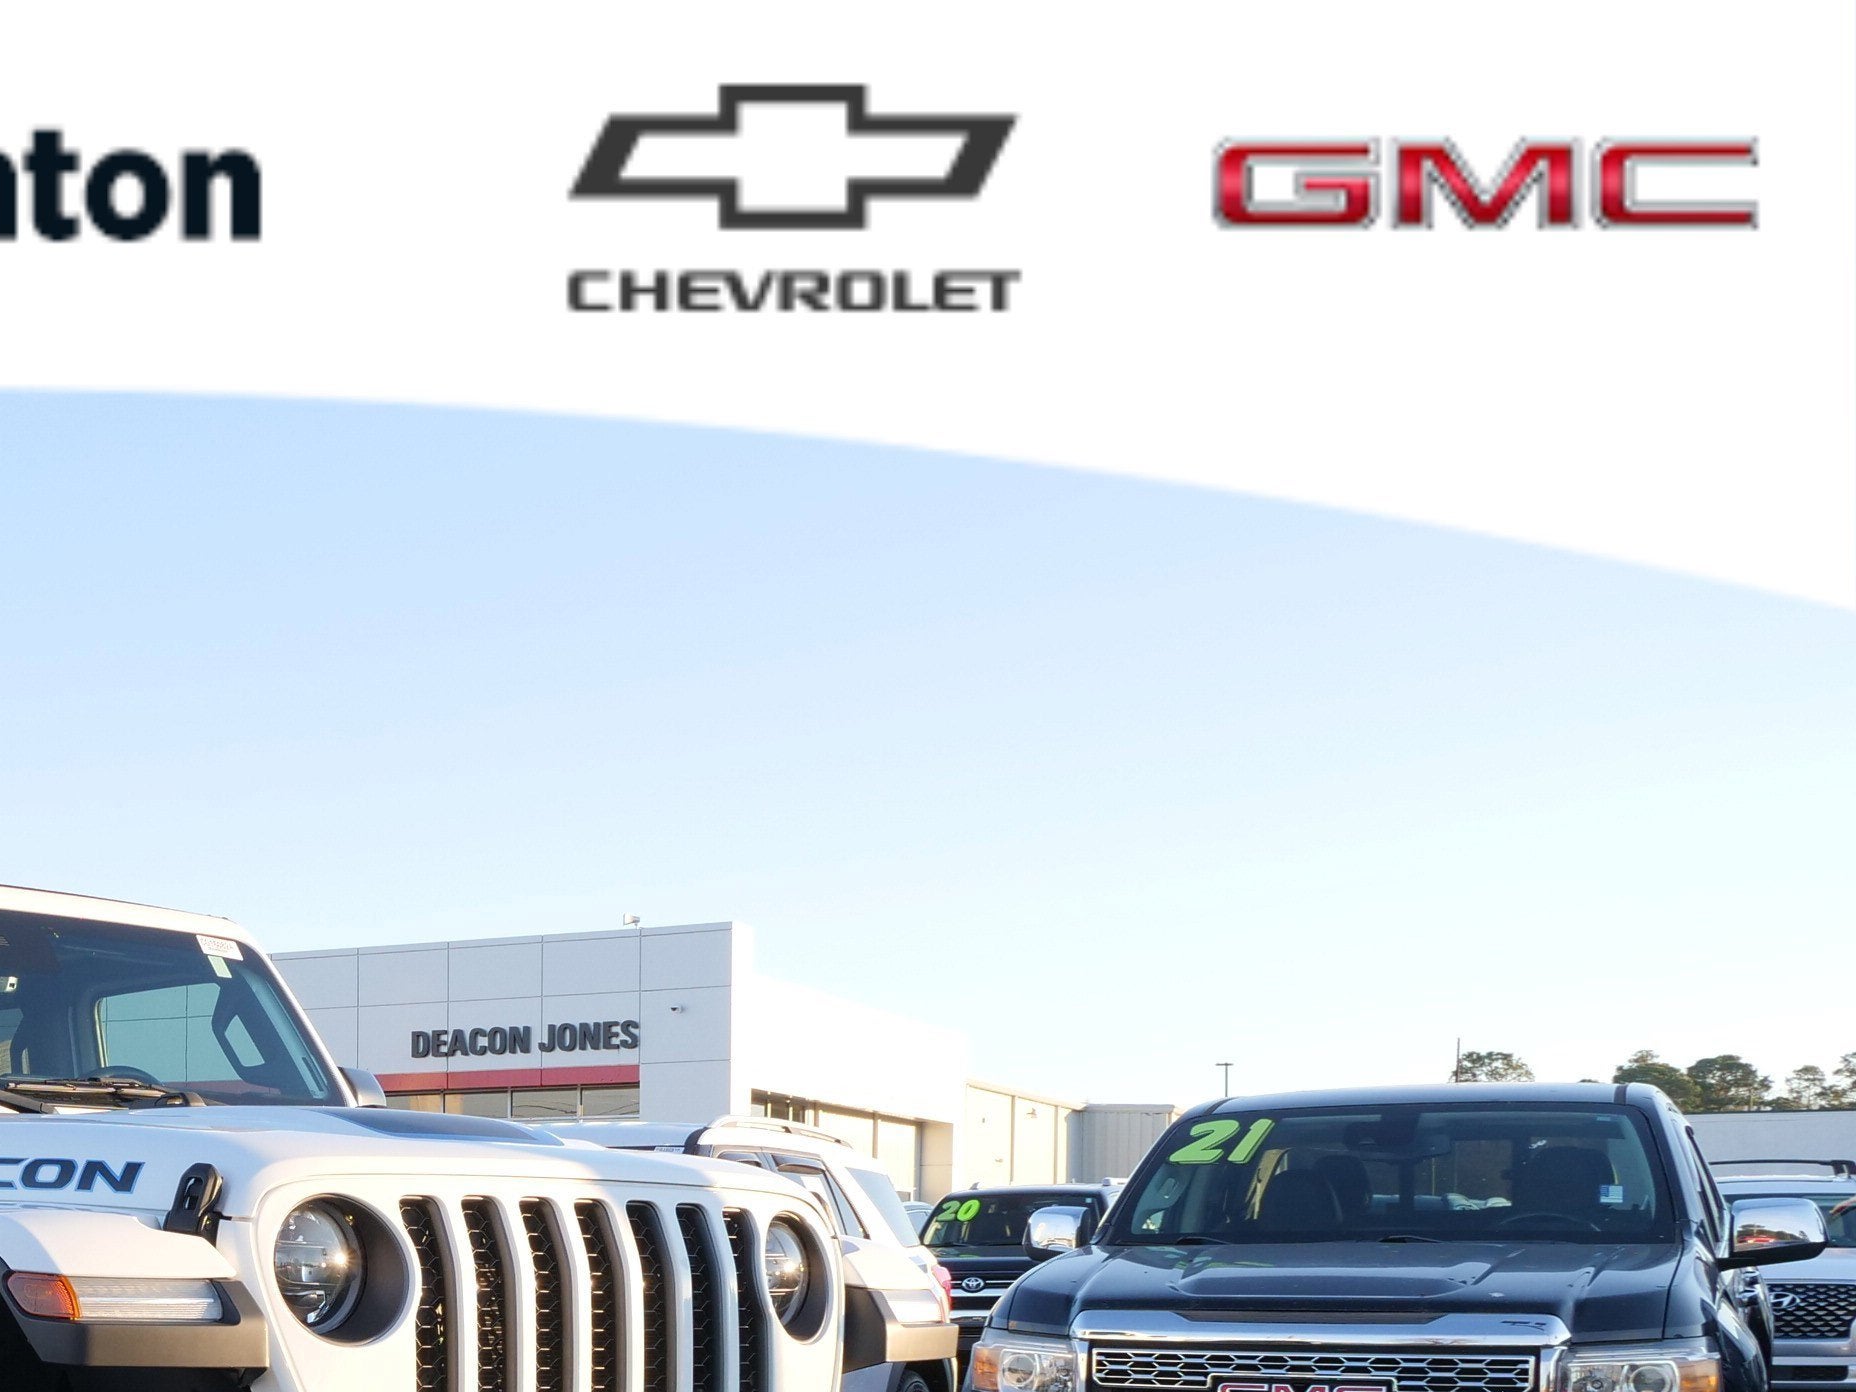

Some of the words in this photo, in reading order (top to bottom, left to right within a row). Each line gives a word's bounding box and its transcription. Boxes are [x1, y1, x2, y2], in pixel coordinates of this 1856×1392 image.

[411, 1026, 531, 1058] DEACON
[538, 1020, 640, 1053] JONES
[1169, 1118, 1275, 1164] 21
[937, 1199, 980, 1222] 20
